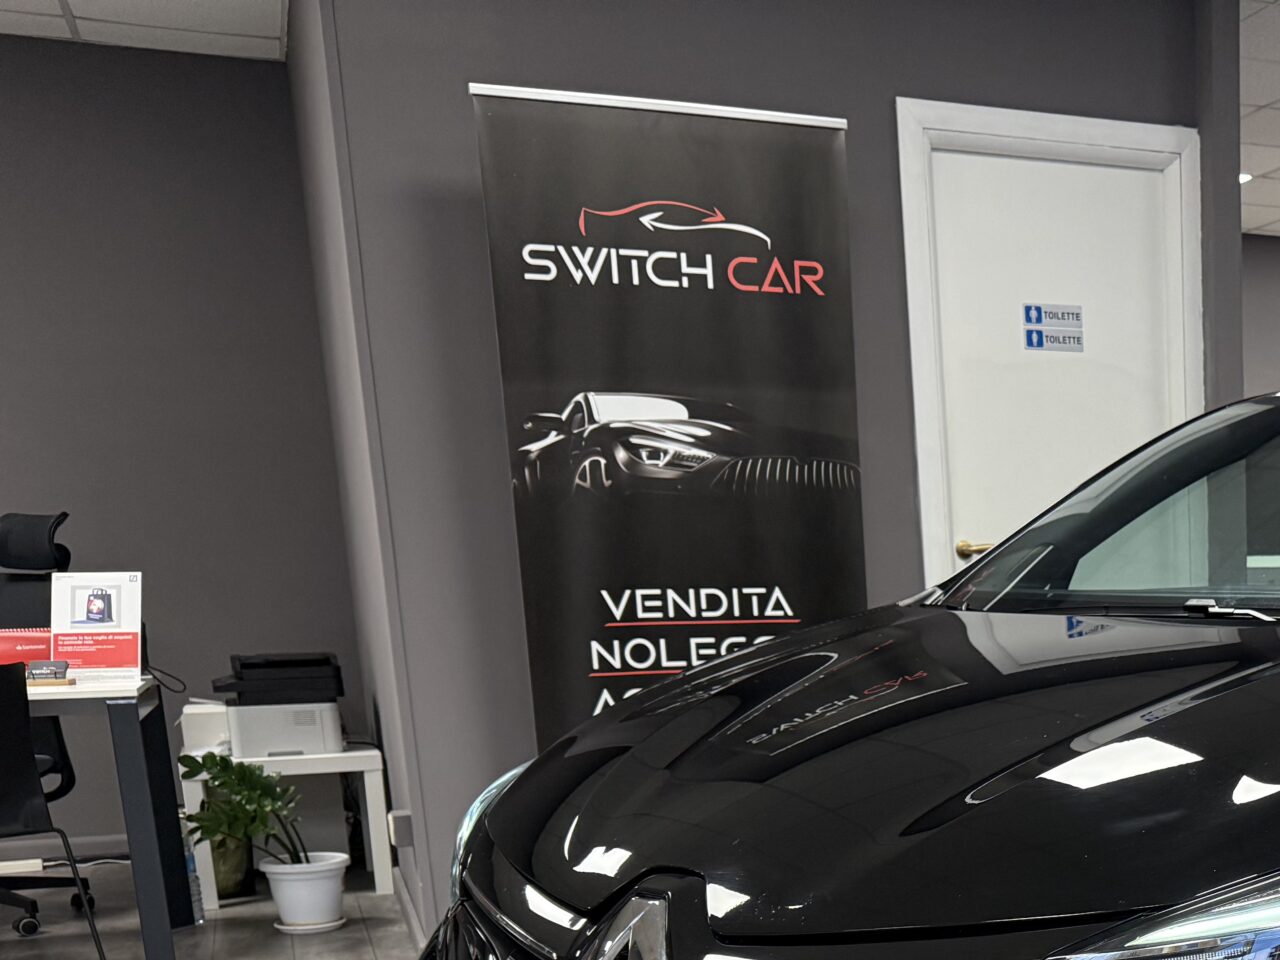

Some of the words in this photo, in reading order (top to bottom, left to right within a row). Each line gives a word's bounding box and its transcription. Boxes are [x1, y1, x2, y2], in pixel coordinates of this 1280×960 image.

[521, 242, 715, 290] SWITCH
[727, 256, 826, 296] CAR
[1043, 310, 1081, 322] TOILETTE
[1044, 334, 1083, 345] TOILETTE
[600, 585, 795, 621] VENDITA
